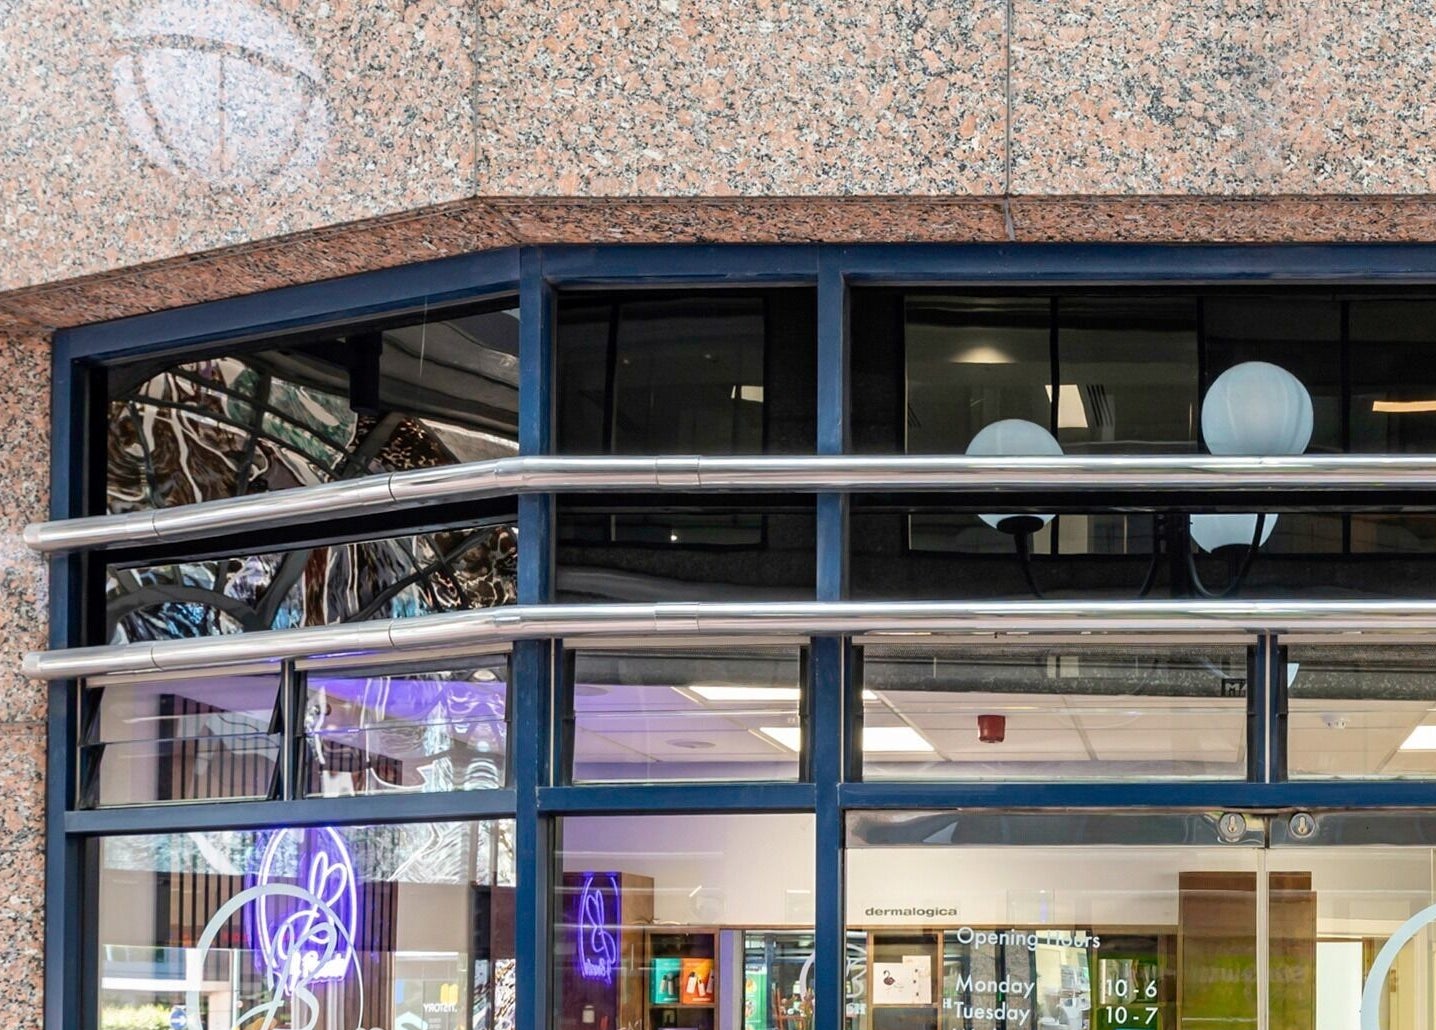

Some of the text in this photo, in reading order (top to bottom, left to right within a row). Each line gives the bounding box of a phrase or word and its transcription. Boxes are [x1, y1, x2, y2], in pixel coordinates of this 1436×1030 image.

[865, 906, 958, 918] dermalogica
[957, 926, 1100, 949] Opening Hours
[955, 975, 1035, 999] Monday
[1106, 979, 1127, 995] 10
[1145, 979, 1158, 998] 6
[953, 1002, 1030, 1026] Tuesday
[1106, 1006, 1127, 1024] 10
[1145, 1006, 1158, 1025] 7
